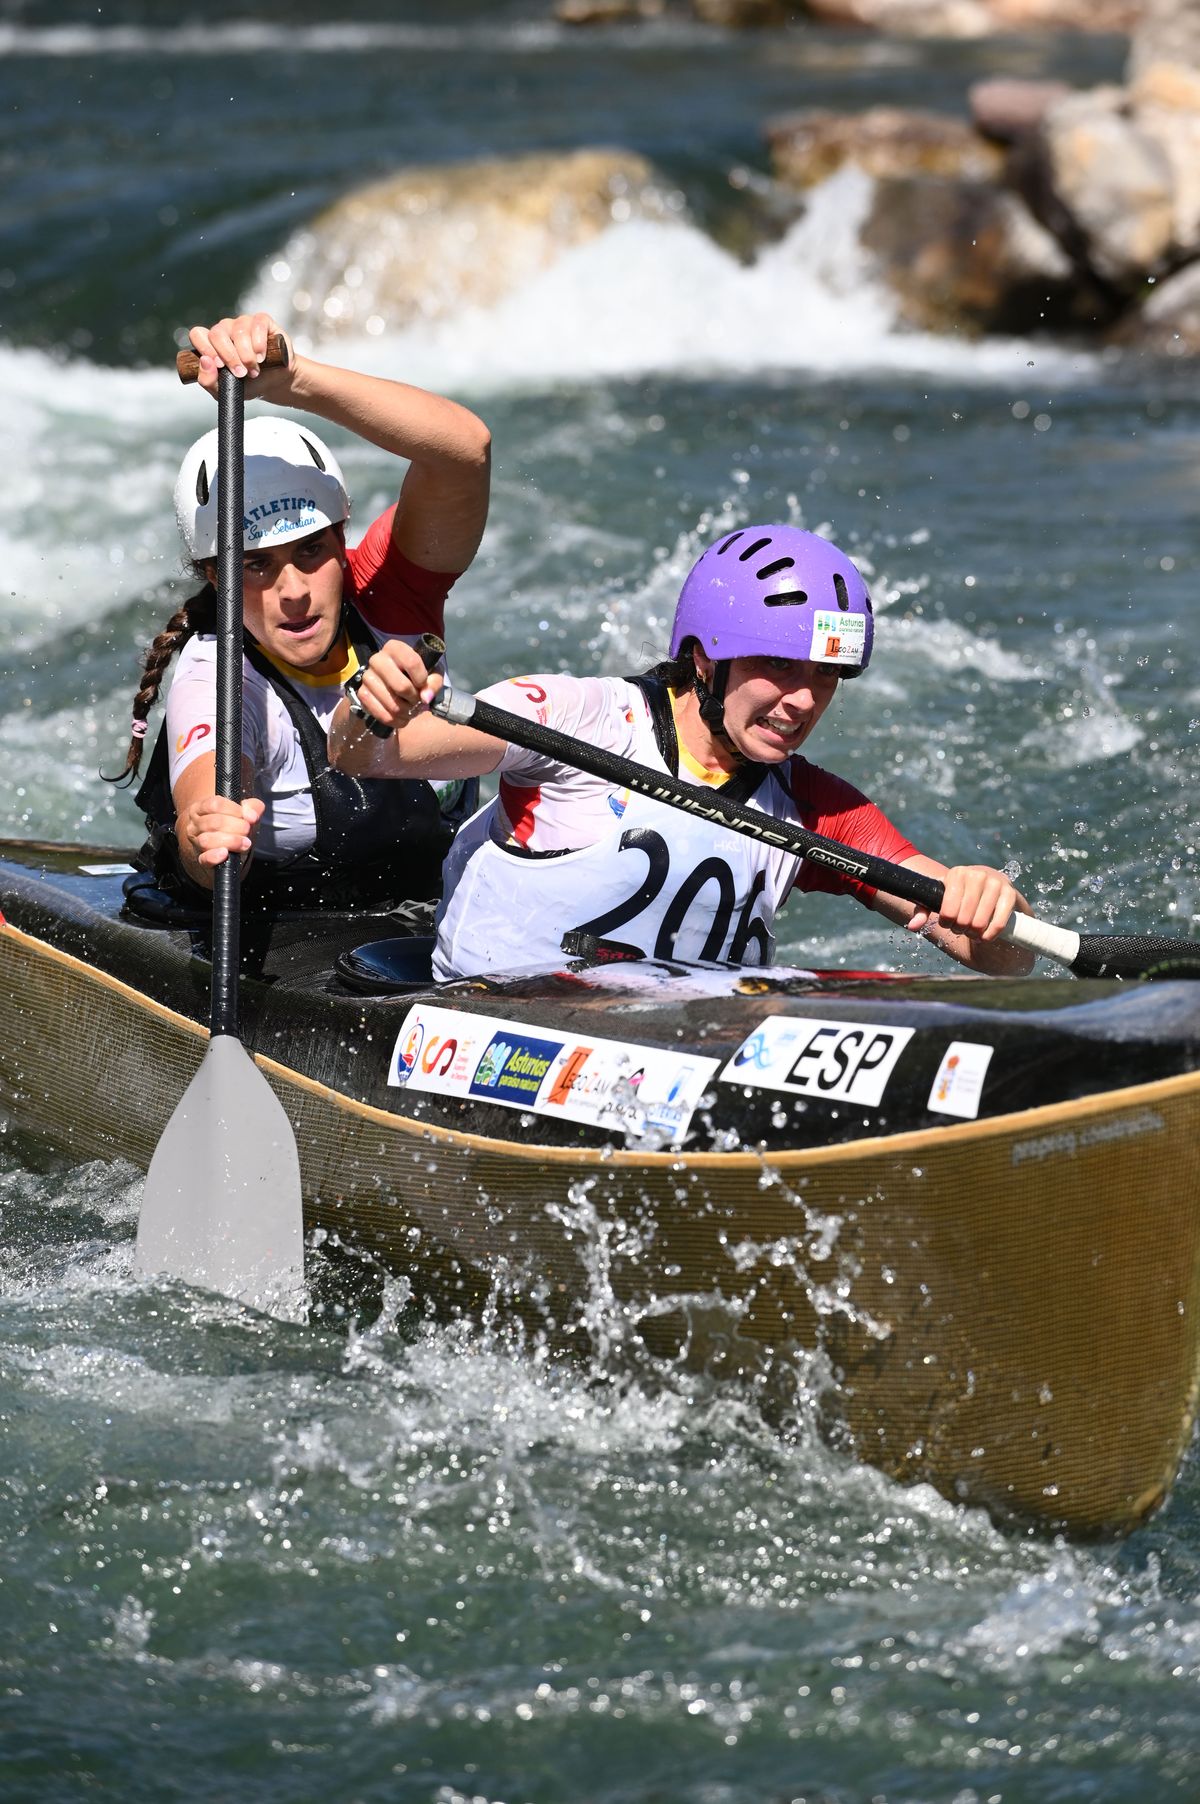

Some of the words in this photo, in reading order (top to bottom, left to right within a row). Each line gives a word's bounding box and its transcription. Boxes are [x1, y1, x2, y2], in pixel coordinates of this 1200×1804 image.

[243, 497, 316, 531] ATLETICO
[248, 524, 268, 541] San
[653, 787, 801, 850] TSUNAMI
[505, 1047, 551, 1077] Asturias
[784, 1028, 894, 1093] ESP
